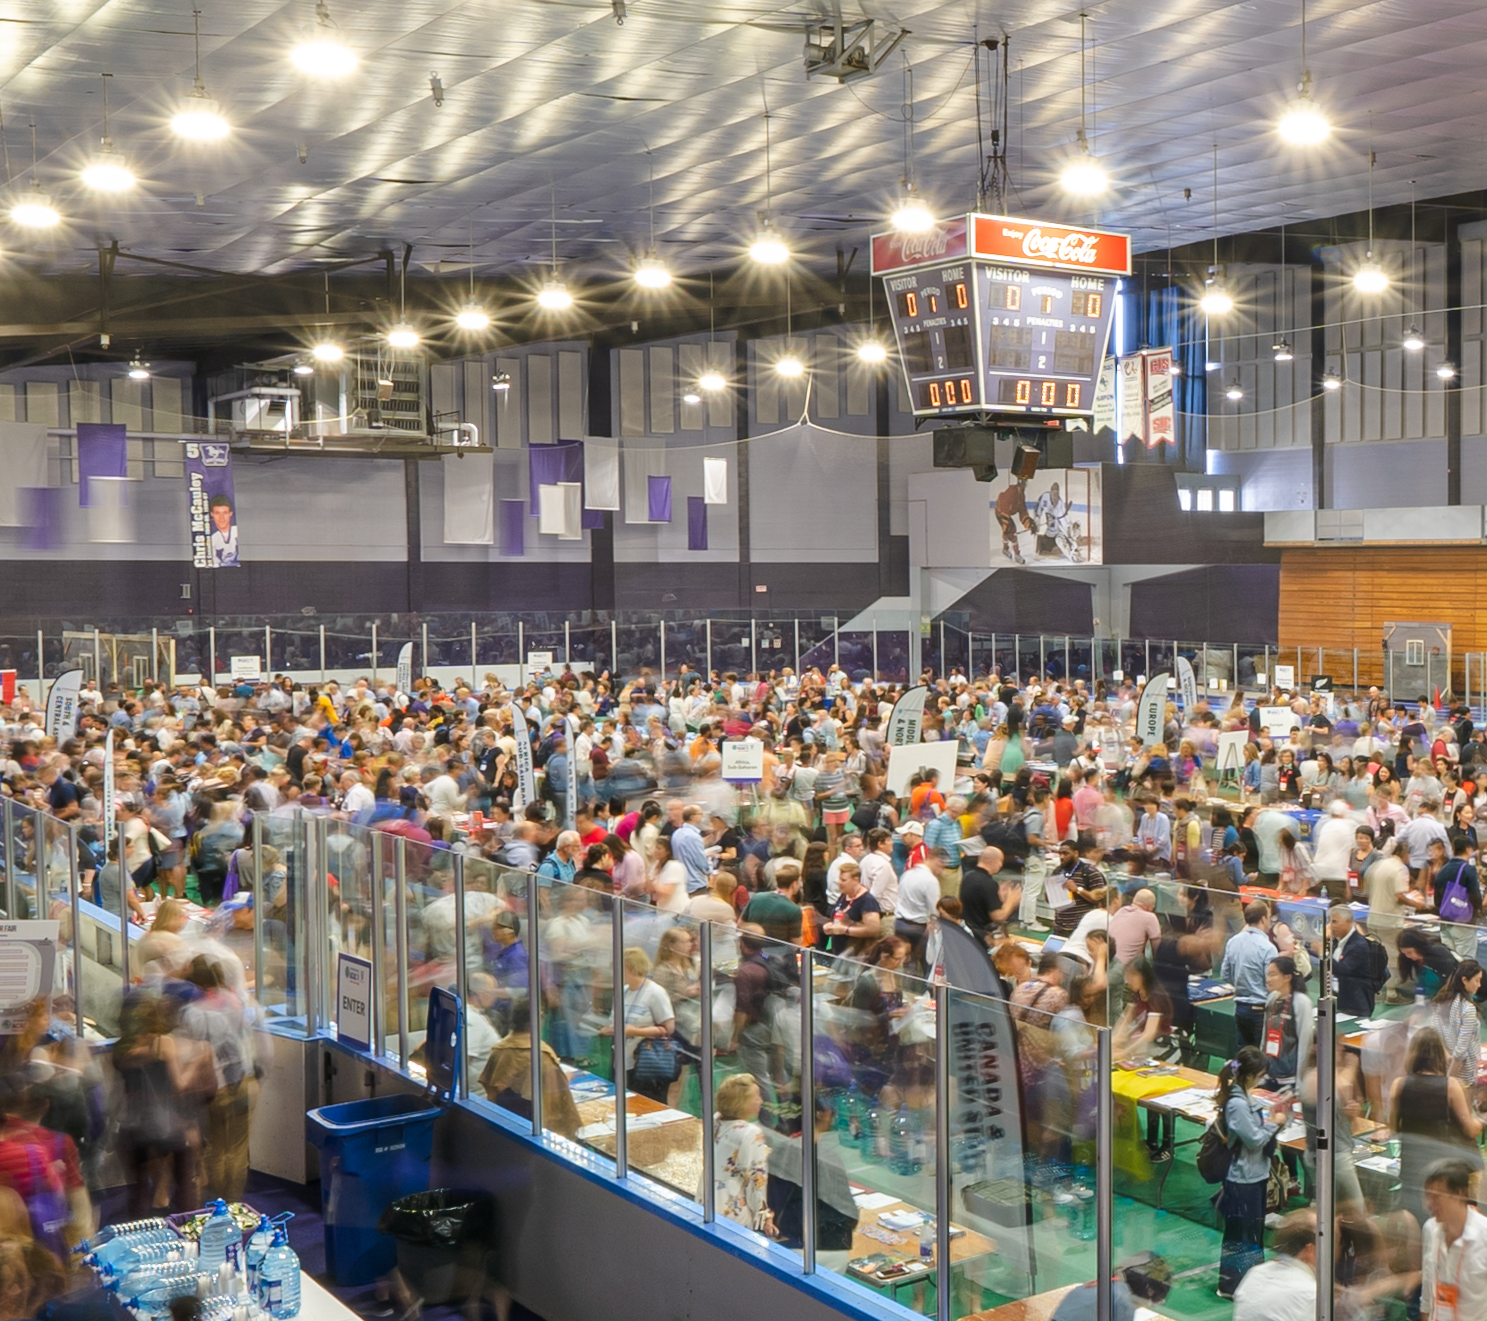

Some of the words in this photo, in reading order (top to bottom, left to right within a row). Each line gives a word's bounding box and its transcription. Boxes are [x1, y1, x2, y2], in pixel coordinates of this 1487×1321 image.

[1002, 229, 1023, 241] Enjoy
[890, 277, 917, 291] VISITOR
[942, 267, 965, 281] HOME
[985, 267, 1030, 283] VISITOR
[1071, 277, 1105, 291] HOME
[921, 287, 940, 299] PERIOD
[956, 284, 968, 309] 0
[1006, 285, 1021, 310] 0
[1031, 286, 1063, 299] PERIOD
[906, 292, 918, 317] 0
[1087, 293, 1101, 318] 0
[923, 317, 946, 327] PENALTIES
[1003, 318, 1009, 326] 4
[1026, 317, 1063, 328] PENALTIES
[935, 332, 939, 345] 1
[1041, 331, 1047, 345] 1
[938, 356, 944, 369] 2
[1038, 356, 1046, 369] 2
[186, 443, 199, 458] 5
[189, 473, 204, 532] McCauley
[194, 535, 206, 568] Chris
[1147, 703, 1157, 736] EUROPE
[907, 720, 916, 745] MIDDL
[343, 995, 365, 1016] ENTER
[975, 1022, 1004, 1117] CANADA
